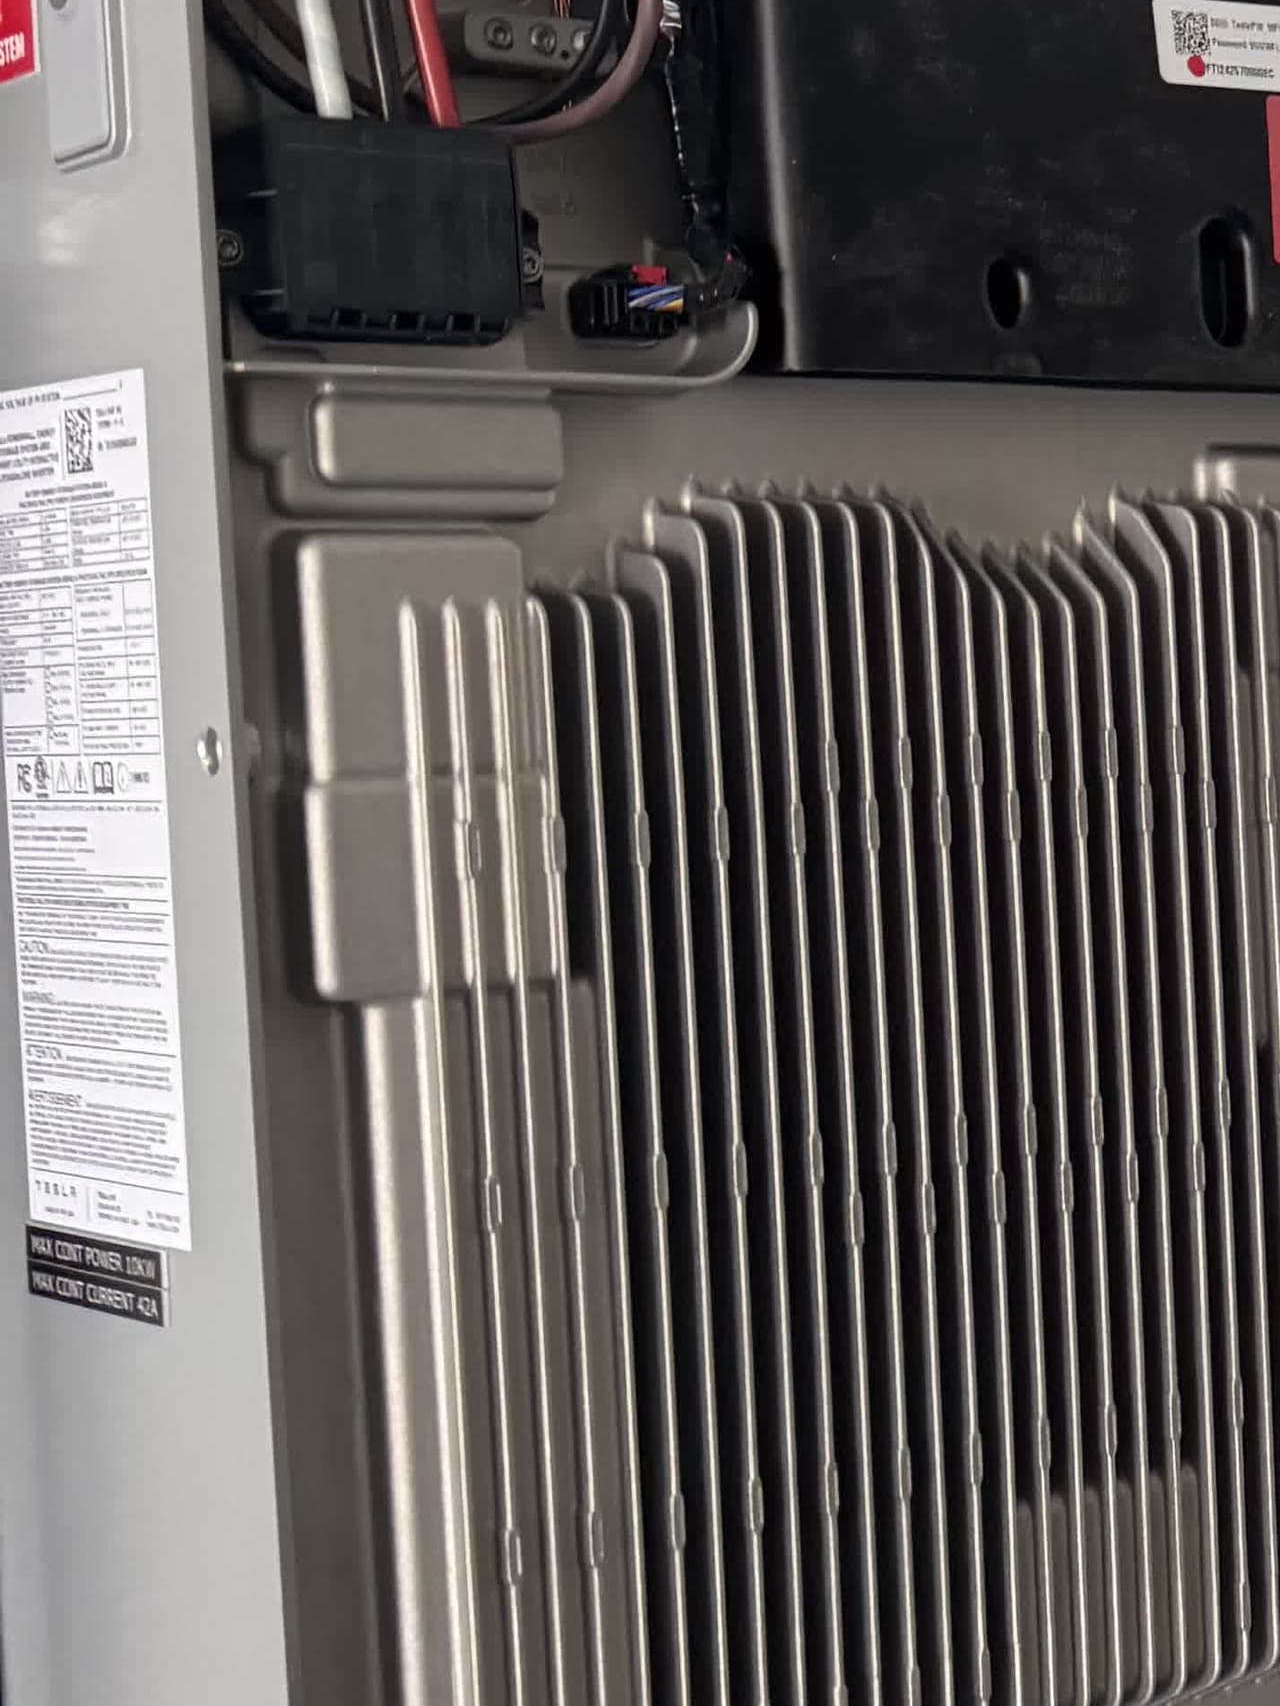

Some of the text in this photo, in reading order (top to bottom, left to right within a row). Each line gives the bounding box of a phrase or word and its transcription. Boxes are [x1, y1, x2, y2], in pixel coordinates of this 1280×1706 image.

[35, 1179, 78, 1199] TESLA
[31, 1235, 54, 1256] MAX
[56, 1241, 84, 1263] CONT
[85, 1246, 124, 1271] POWER
[32, 1273, 158, 1319] MAX CONT CURRENT 42A
